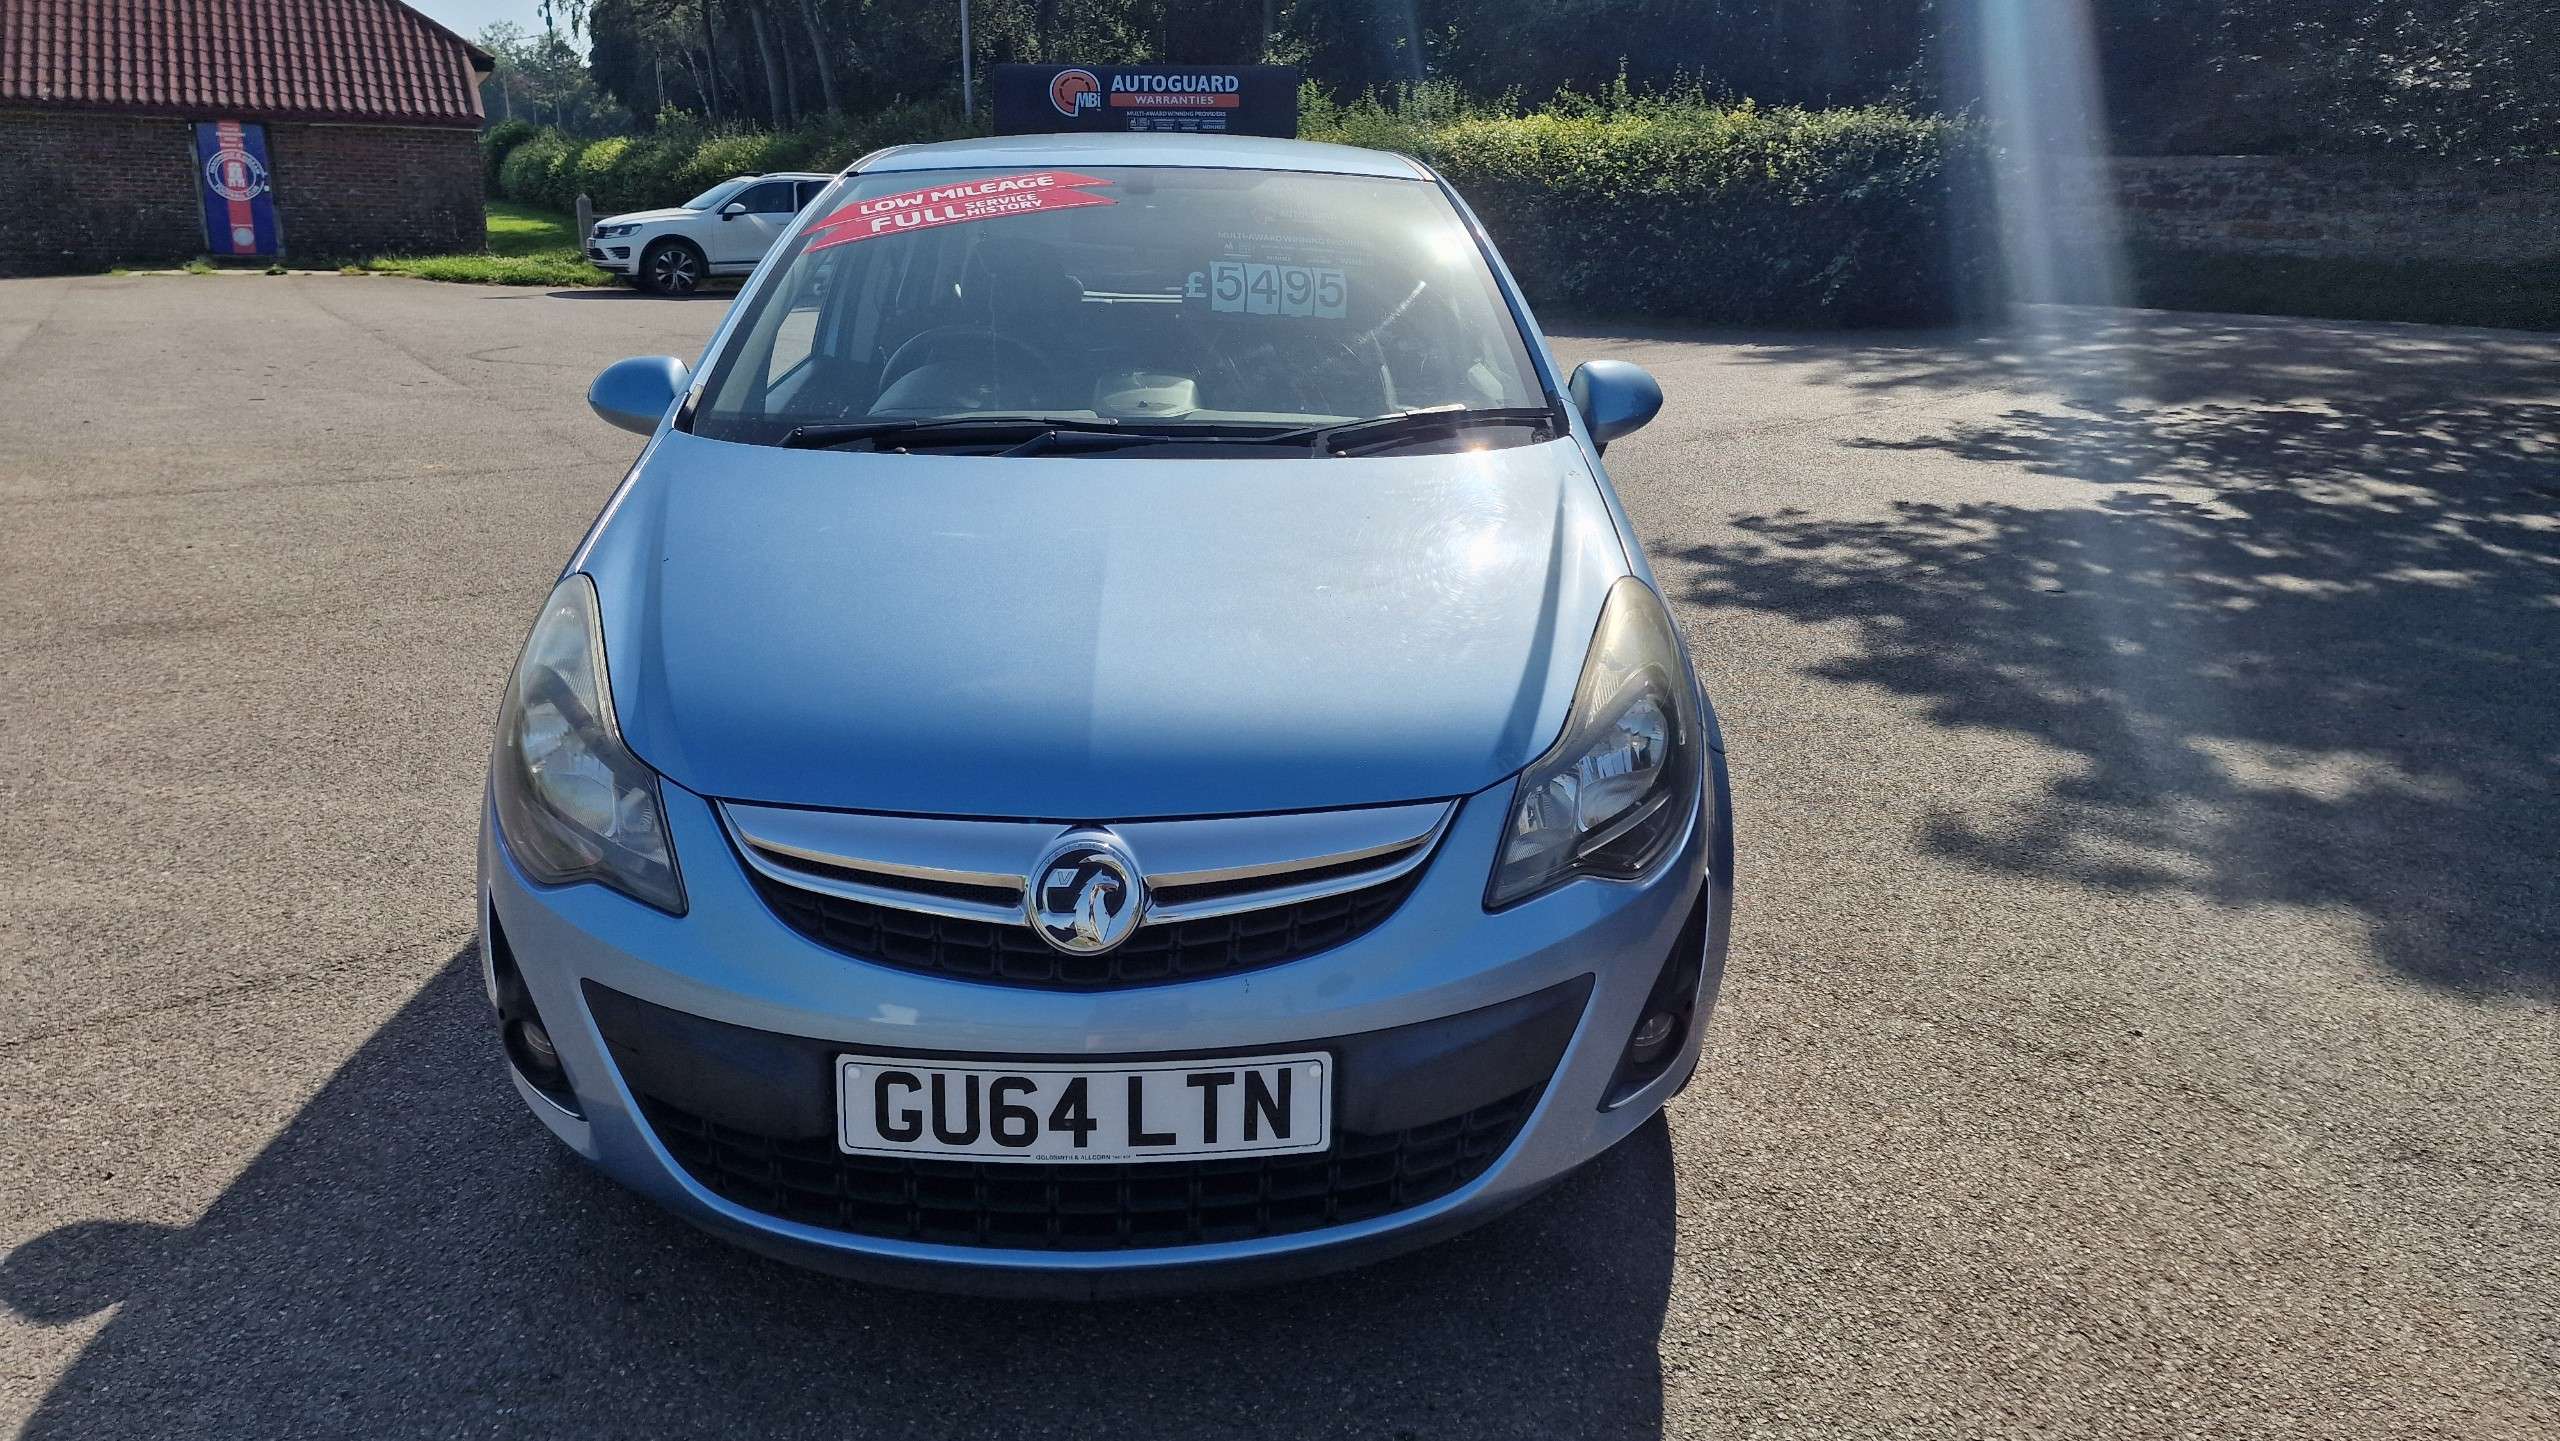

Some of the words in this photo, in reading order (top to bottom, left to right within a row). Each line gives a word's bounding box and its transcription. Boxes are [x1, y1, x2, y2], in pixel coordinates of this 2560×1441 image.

[1111, 75, 1239, 92] AUTOGUARD
[1135, 95, 1214, 105] WARRANTIES
[860, 194, 924, 215] LOW
[931, 176, 1055, 202] MILEAGE
[966, 192, 1038, 210] SERVICE
[967, 200, 1042, 217] HISTORY
[871, 205, 966, 232] FULL
[874, 1070, 1097, 1148] GU64
[1128, 1067, 1292, 1147] LTN
